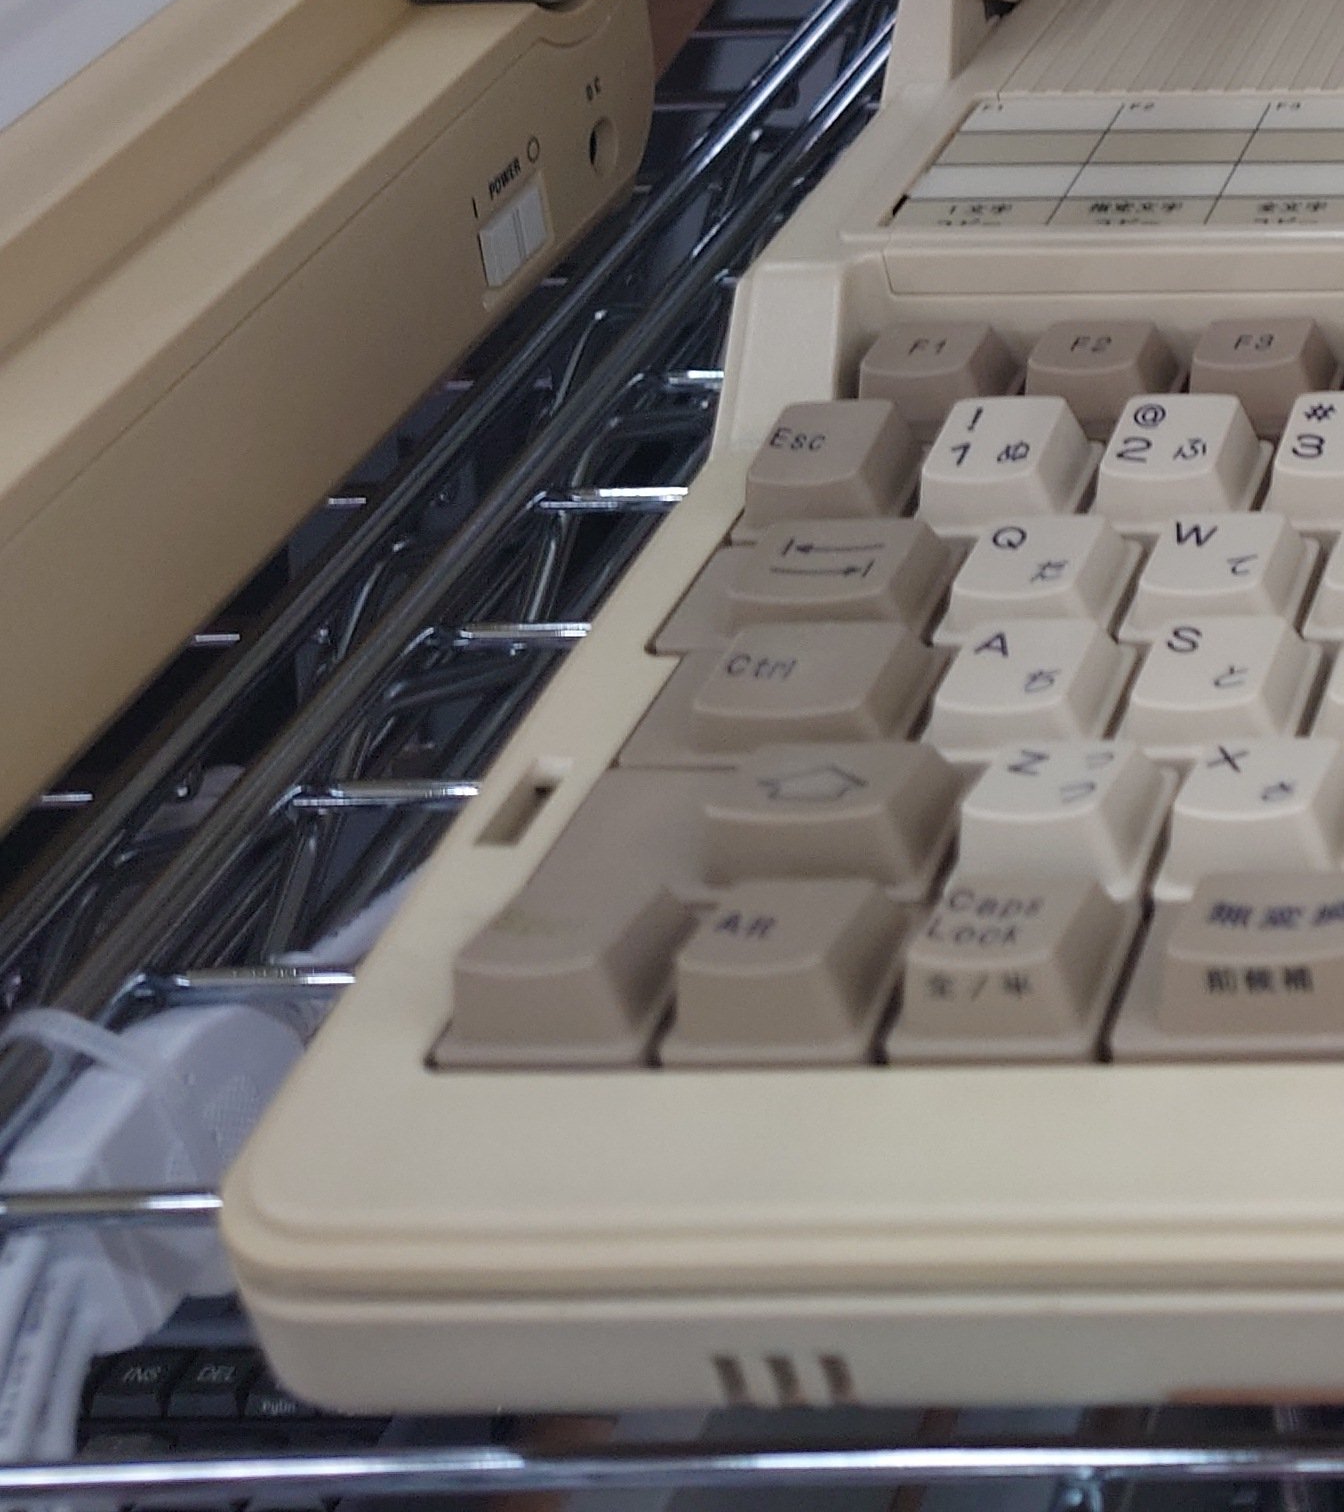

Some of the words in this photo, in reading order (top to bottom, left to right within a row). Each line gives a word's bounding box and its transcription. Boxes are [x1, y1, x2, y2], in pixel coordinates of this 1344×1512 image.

[488, 157, 521, 201] POWER
[908, 339, 946, 355] F1
[1070, 337, 1112, 352] F2
[1234, 334, 1274, 350] F3
[1133, 405, 1166, 427] @
[1305, 404, 1335, 421] #
[769, 427, 825, 451] Esc
[1116, 437, 1152, 462] 2
[1292, 434, 1325, 458] 3
[952, 443, 970, 466] 1
[992, 527, 1027, 550] Q
[1176, 522, 1217, 547] W
[974, 632, 1008, 657] A
[1167, 627, 1202, 653] S
[724, 653, 796, 678] Ctrl
[1007, 750, 1049, 775] Z
[1209, 746, 1246, 772] X
